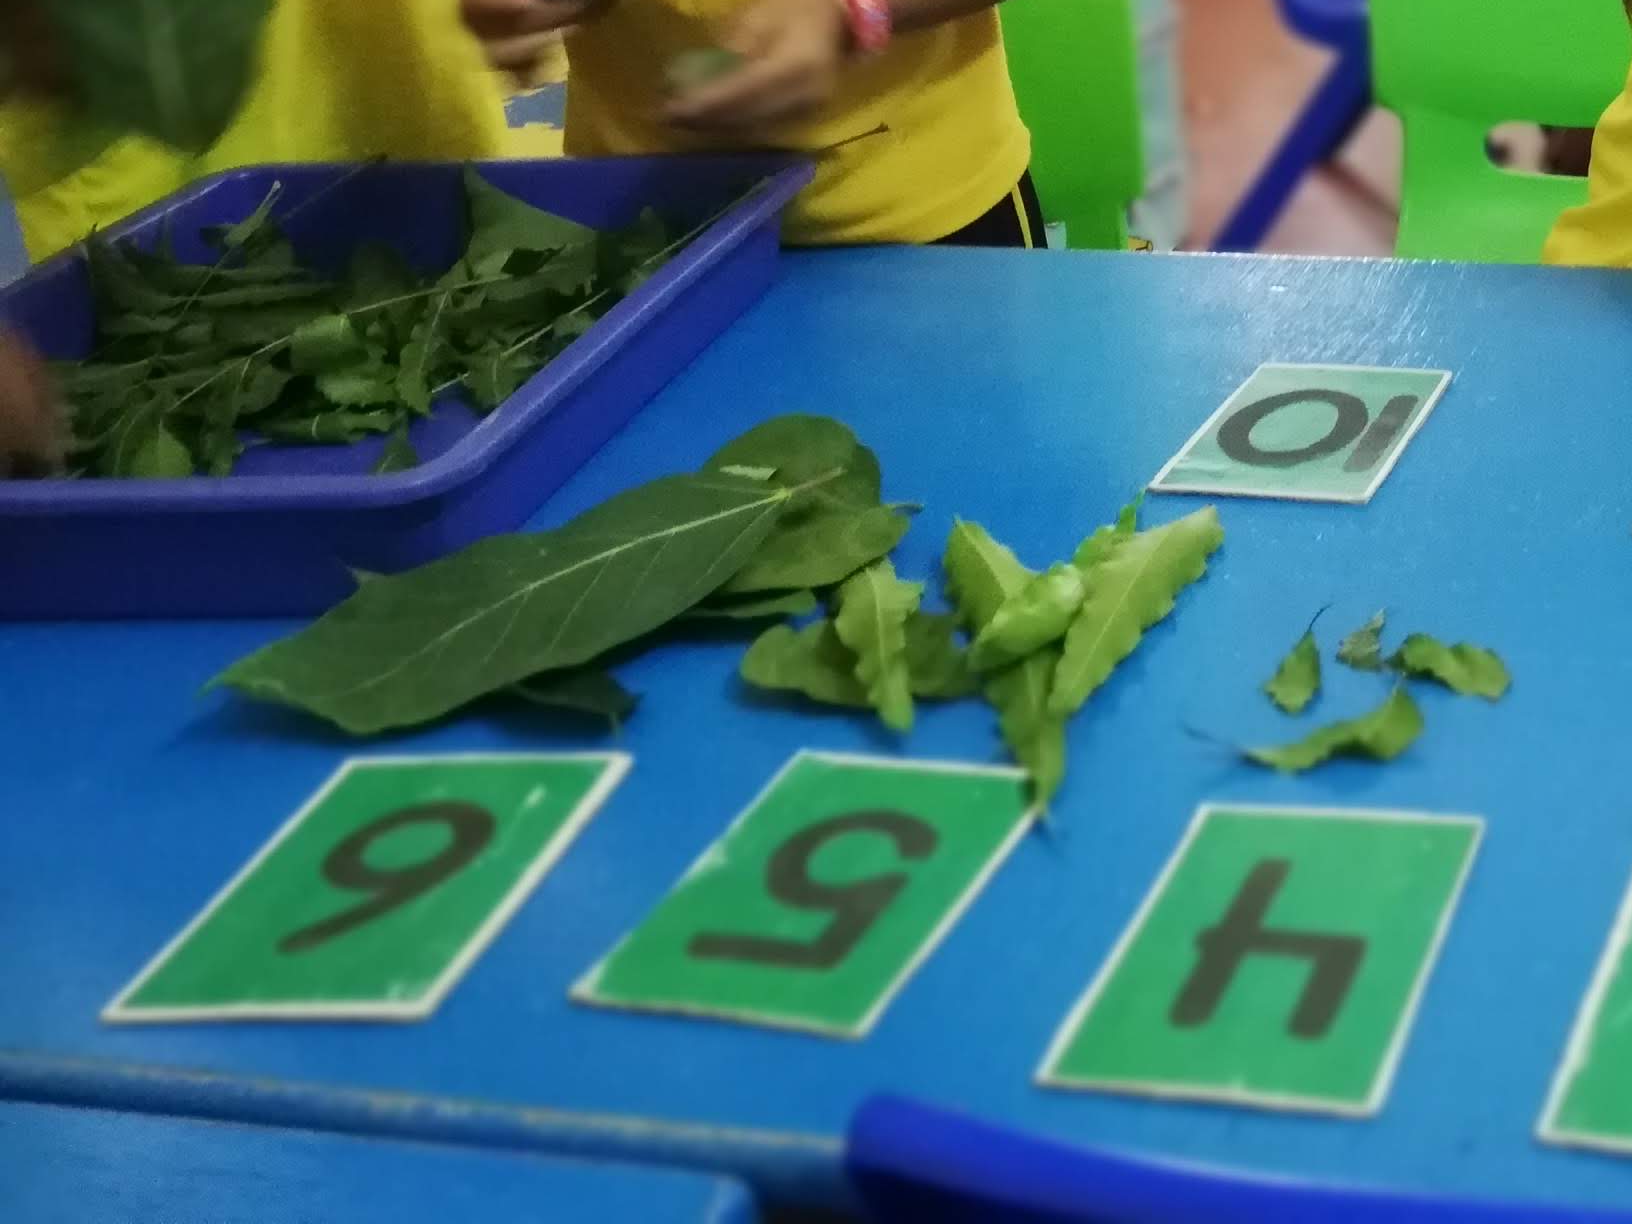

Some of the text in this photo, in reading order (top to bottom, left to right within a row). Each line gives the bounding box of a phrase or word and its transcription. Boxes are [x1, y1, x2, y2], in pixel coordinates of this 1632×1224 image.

[1216, 389, 1418, 472] 10
[276, 800, 497, 955] 6
[685, 809, 939, 971] 5
[1168, 860, 1366, 1040] 4
